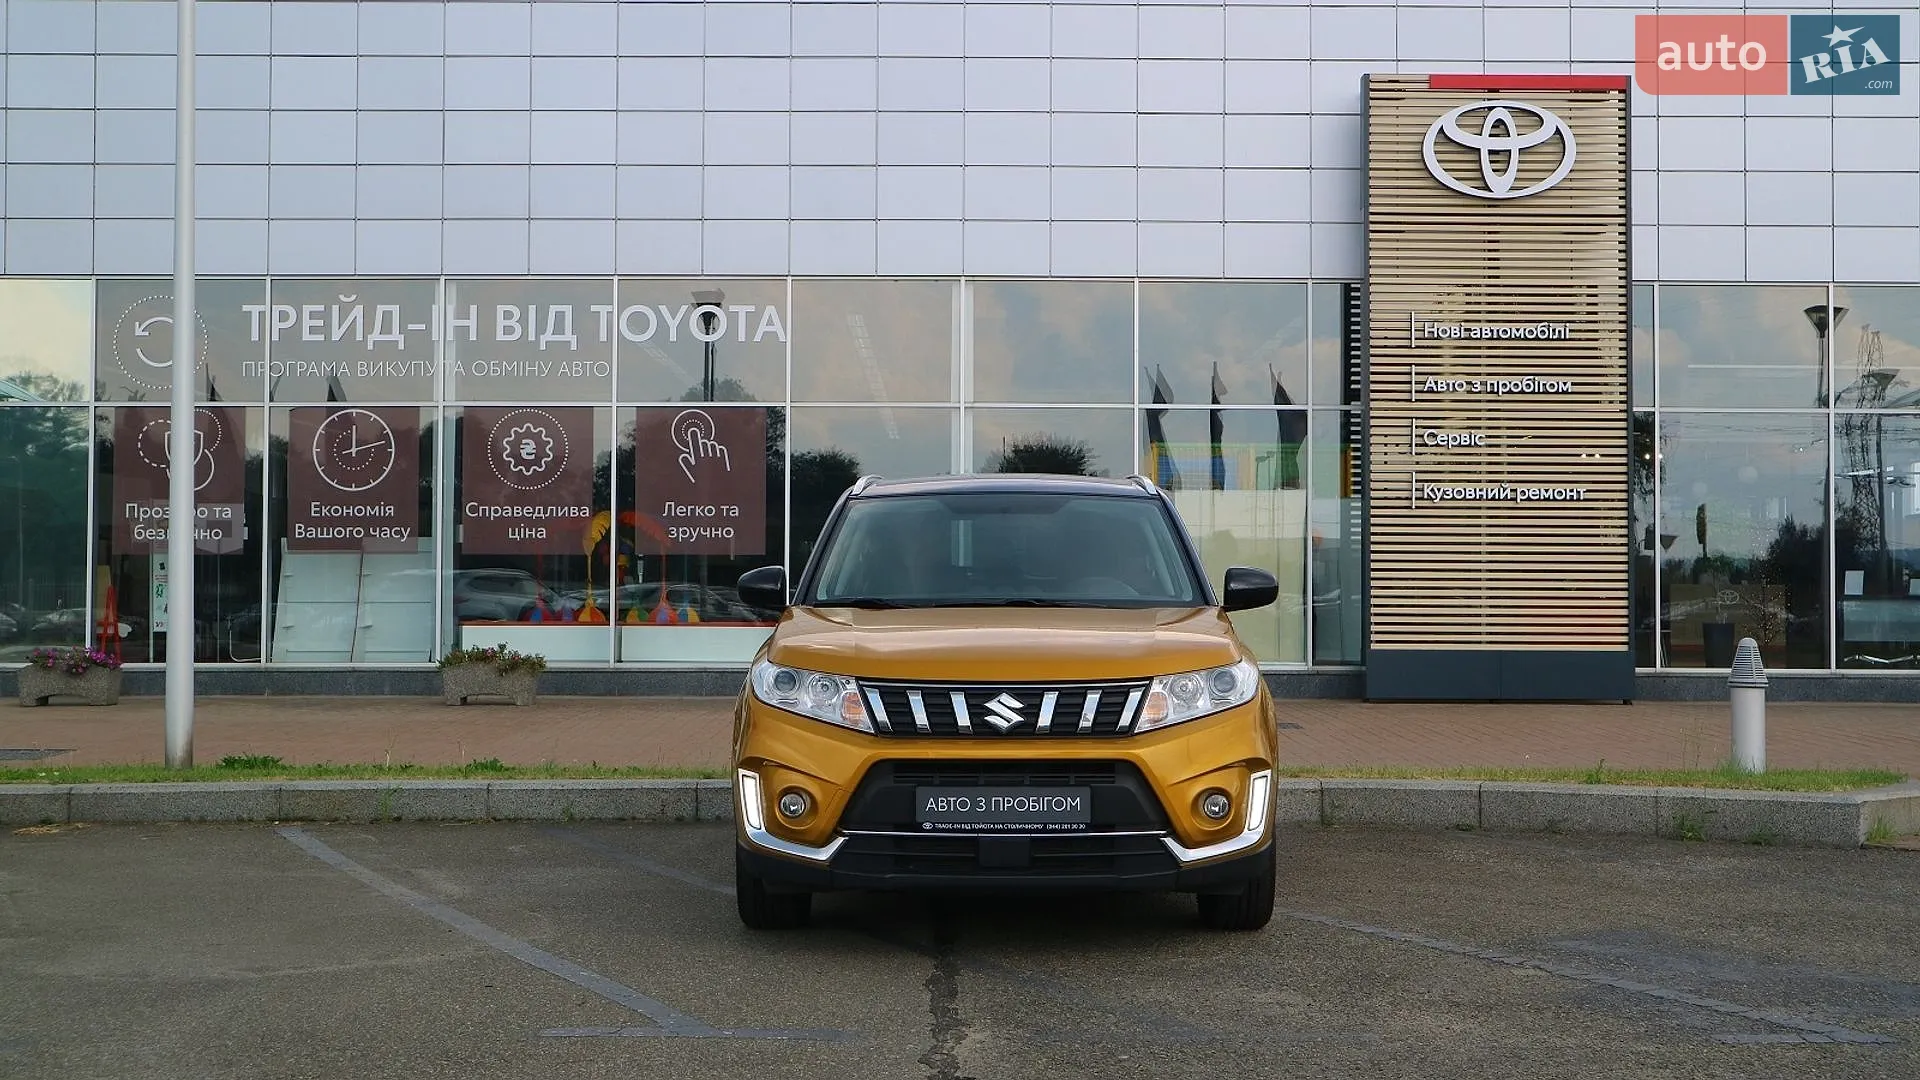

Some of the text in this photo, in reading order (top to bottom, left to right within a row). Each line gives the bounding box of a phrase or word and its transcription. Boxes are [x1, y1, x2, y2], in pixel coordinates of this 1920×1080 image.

[242, 294, 787, 350] ТРЕЙД-ІН ВІД TOYOTA
[1423, 322, 1570, 339] Нові автомобілі
[242, 360, 350, 377] ПРОГРАМА
[357, 360, 437, 377] ВИКУПУ
[472, 360, 552, 377] ОБМІНУ
[558, 360, 610, 377] АВТО
[1423, 376, 1572, 396] Авто з пробігом
[1423, 430, 1485, 449] Сервіс
[1423, 483, 1586, 503] Кузовний ремонт
[126, 503, 232, 521] Прозо та
[310, 502, 394, 518] Економія
[465, 502, 590, 520] Справедлива
[662, 501, 739, 518] Легко та
[295, 524, 411, 541] Вашого часу
[508, 524, 547, 541] ціна
[668, 525, 735, 542] зручно
[925, 797, 971, 812] АВТО
[991, 797, 1081, 812] ПРОБІГОМ
